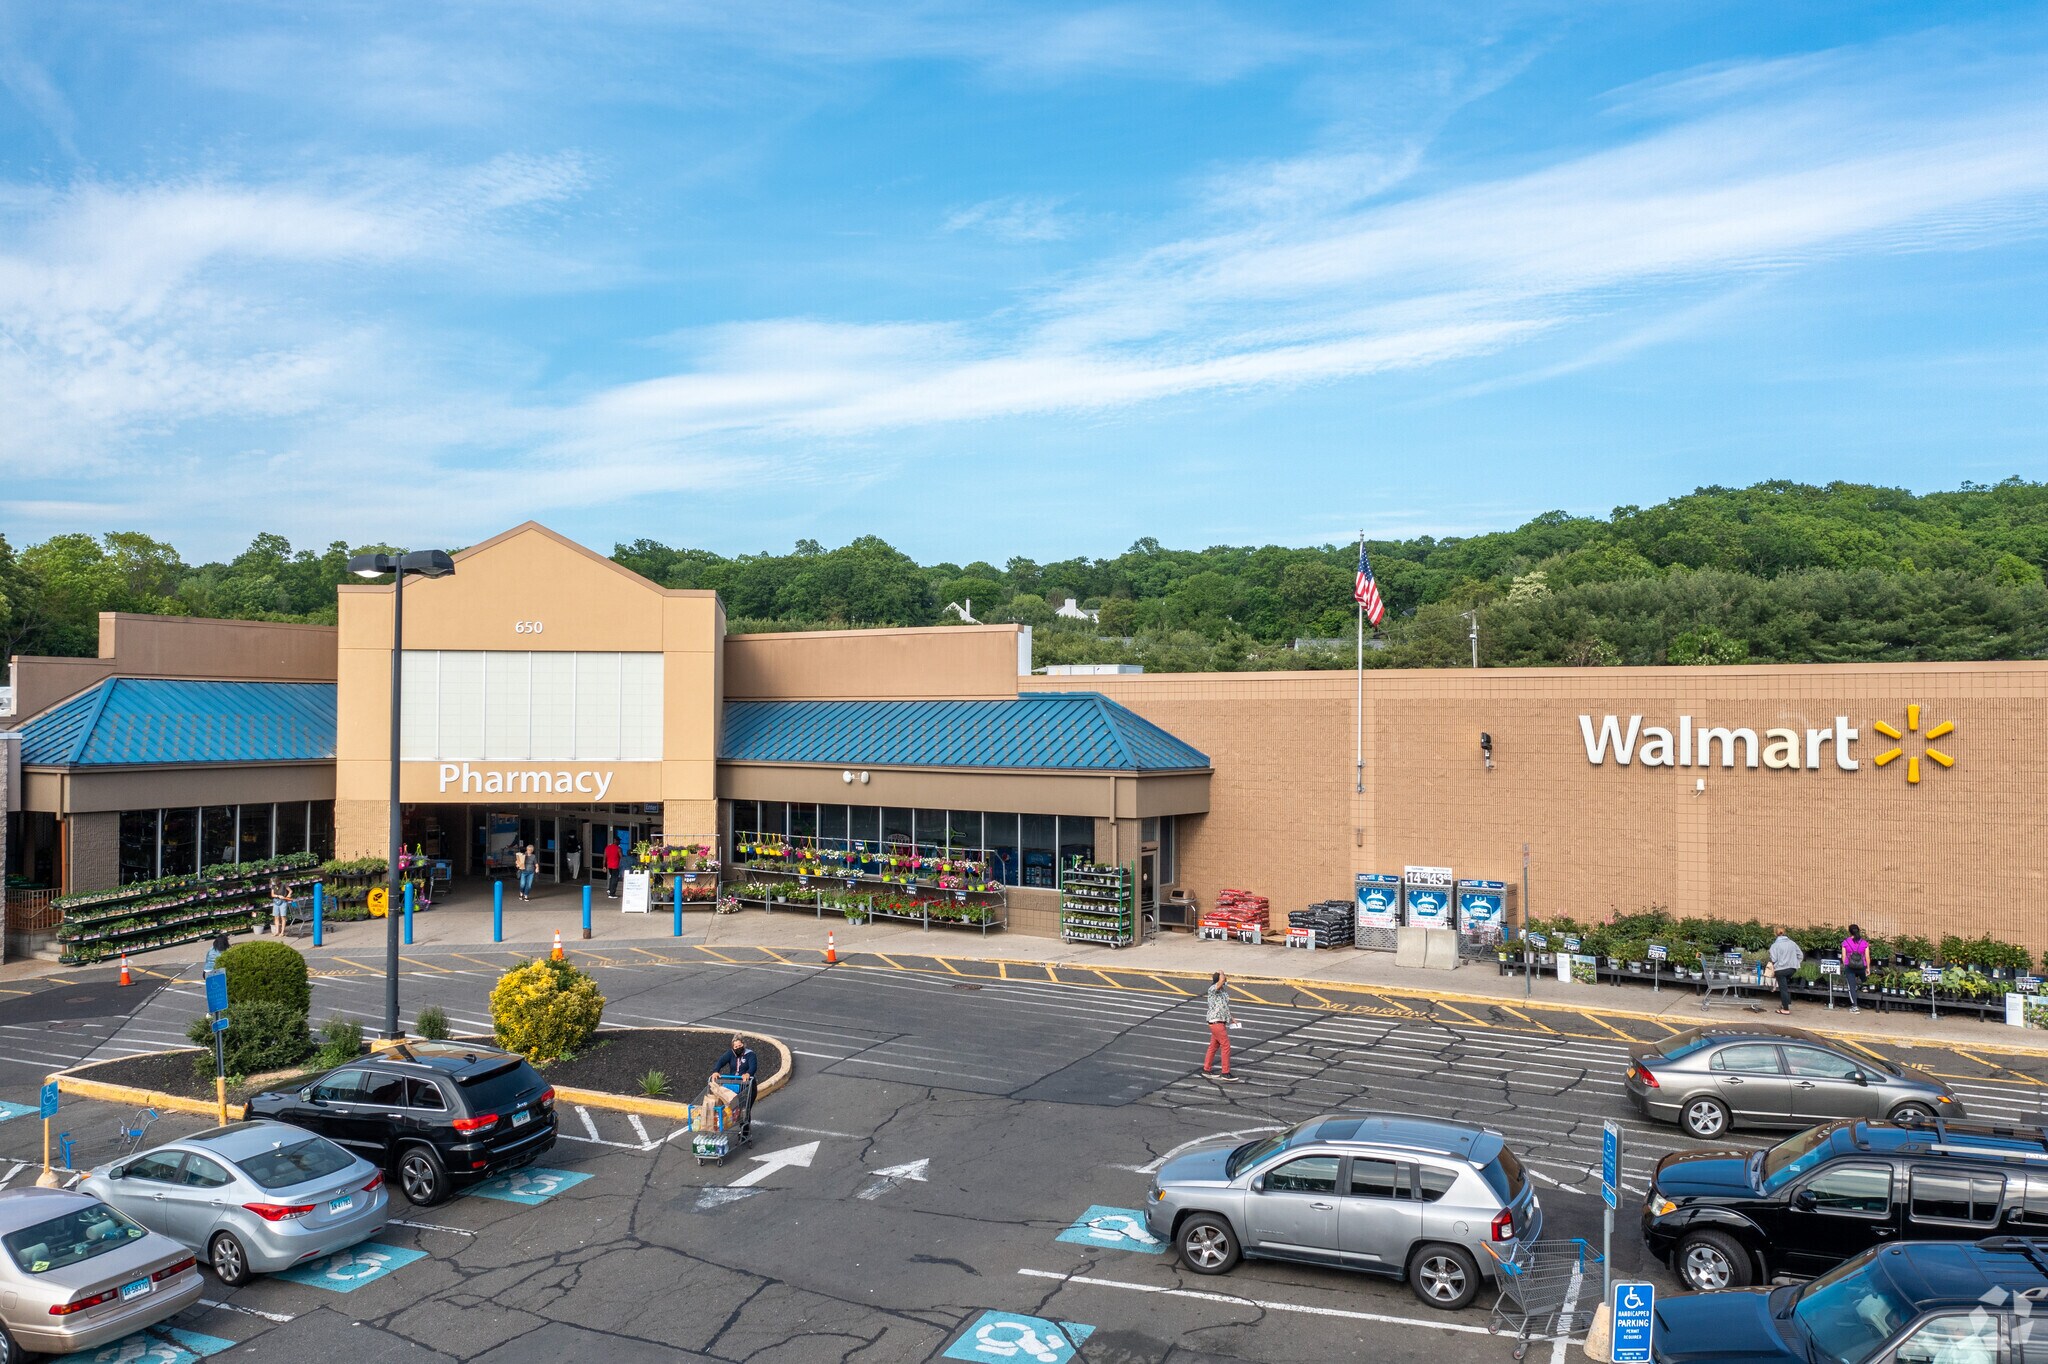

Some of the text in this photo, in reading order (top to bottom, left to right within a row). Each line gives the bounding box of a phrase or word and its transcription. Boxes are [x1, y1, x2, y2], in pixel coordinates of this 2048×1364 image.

[515, 621, 543, 634] 650
[1578, 715, 1859, 771] Walmart
[439, 762, 614, 801] Pharmacy
[1319, 1002, 1440, 1019] NO PARKING
[1617, 1319, 1649, 1328] PARKING
